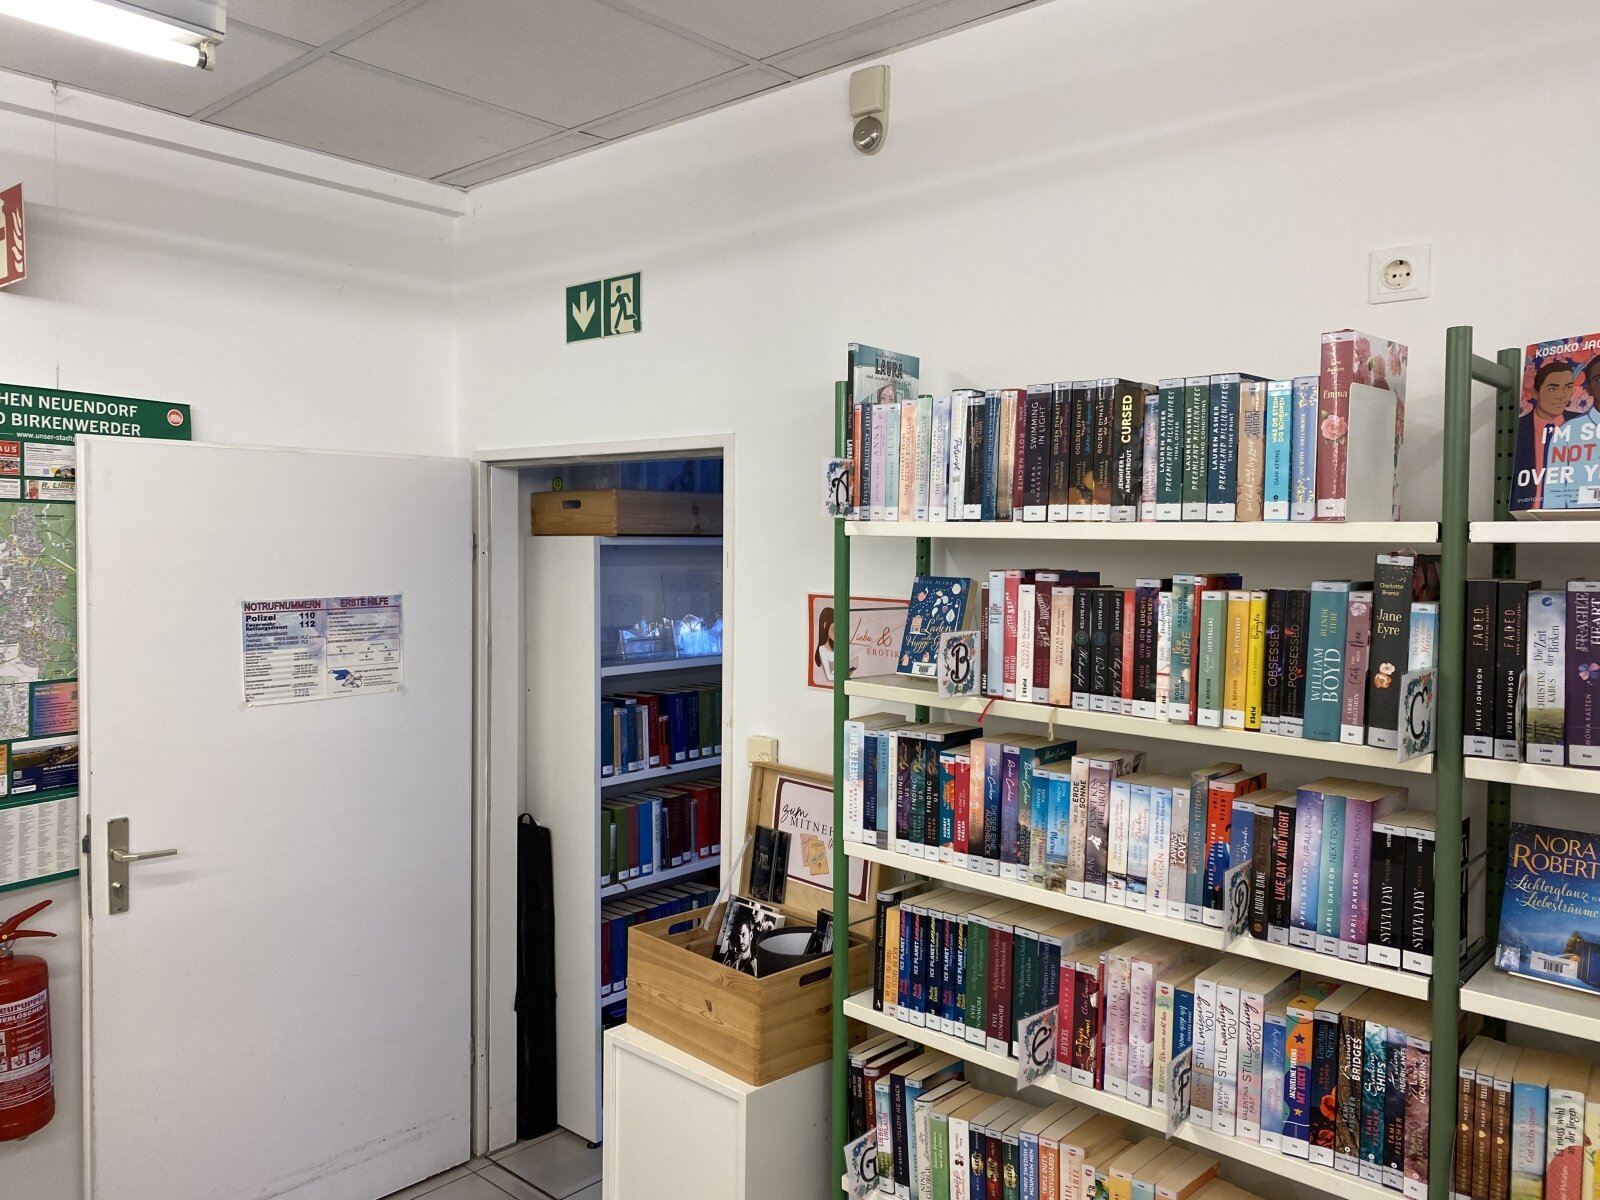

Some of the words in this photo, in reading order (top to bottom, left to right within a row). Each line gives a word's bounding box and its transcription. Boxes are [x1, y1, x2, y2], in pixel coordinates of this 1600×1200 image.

[1535, 343, 1578, 357] KOSOKO
[876, 358, 903, 379] LAURA
[39, 395, 138, 417] NEUENDORF
[12, 413, 141, 436] BIRKENWERDER
[1030, 402, 1038, 449] SWIMMING
[1121, 395, 1132, 443] CURSED
[1038, 436, 1044, 445] IN
[1552, 444, 1596, 463] NOT
[1517, 466, 1574, 487] OVER
[244, 600, 321, 611] NOTRUFNUMMERN
[341, 598, 366, 607] ERSTE
[368, 597, 388, 606] HILFE
[1377, 609, 1402, 622] Jane
[850, 618, 872, 647] Liebe
[877, 627, 892, 647] &
[1377, 623, 1400, 638] Eyre
[1473, 608, 1484, 646] FADED
[1504, 609, 1516, 648] FADED
[1534, 630, 1547, 649] Zeit
[1546, 626, 1560, 653] Birken
[1182, 631, 1191, 664] HOPE
[1268, 624, 1279, 686] OBSESSED
[1288, 624, 1299, 688] POSSESSED
[1534, 648, 1543, 661] Die
[1544, 654, 1554, 666] der
[1311, 647, 1323, 701] WILLIAM
[1322, 648, 1341, 703] BOYD
[849, 732, 859, 758] ENEMY
[849, 760, 859, 784] SWEET
[905, 787, 910, 796] US
[918, 790, 923, 799] US
[780, 804, 808, 823] zum
[1278, 810, 1290, 838] NIGHT
[1330, 810, 1338, 828] YOU
[1330, 829, 1337, 841] TO
[1534, 833, 1597, 860] NORA
[1177, 837, 1186, 864] LOVE
[1277, 840, 1288, 859] AND
[1513, 843, 1600, 879] ROBERT
[1256, 870, 1266, 888] DANE
[1276, 861, 1287, 878] DAY
[1274, 881, 1286, 900] LIKE
[1381, 883, 1393, 905] DAY
[1413, 887, 1425, 911] DAY
[1510, 874, 1591, 903] Lichterglanz
[1254, 890, 1265, 914] LAUREN
[1519, 892, 1599, 918] Liebesträume
[1380, 906, 1393, 943] SYLVIA
[1413, 912, 1424, 949] SYLVIA
[1195, 992, 1210, 1039] missing
[1205, 1010, 1214, 1032] YOU
[1219, 1002, 1235, 1046] wanting
[1241, 1000, 1259, 1054] searching
[1228, 1018, 1237, 1040] YOU
[1253, 1024, 1262, 1047] YOU
[1195, 1040, 1205, 1069] STILL
[1218, 1048, 1227, 1077] STILL
[1352, 1037, 1362, 1081] BRIDGES
[1242, 1054, 1253, 1083] STILL
[1376, 1062, 1386, 1092] SHIPS
[1399, 1047, 1407, 1093] HURRICANES
